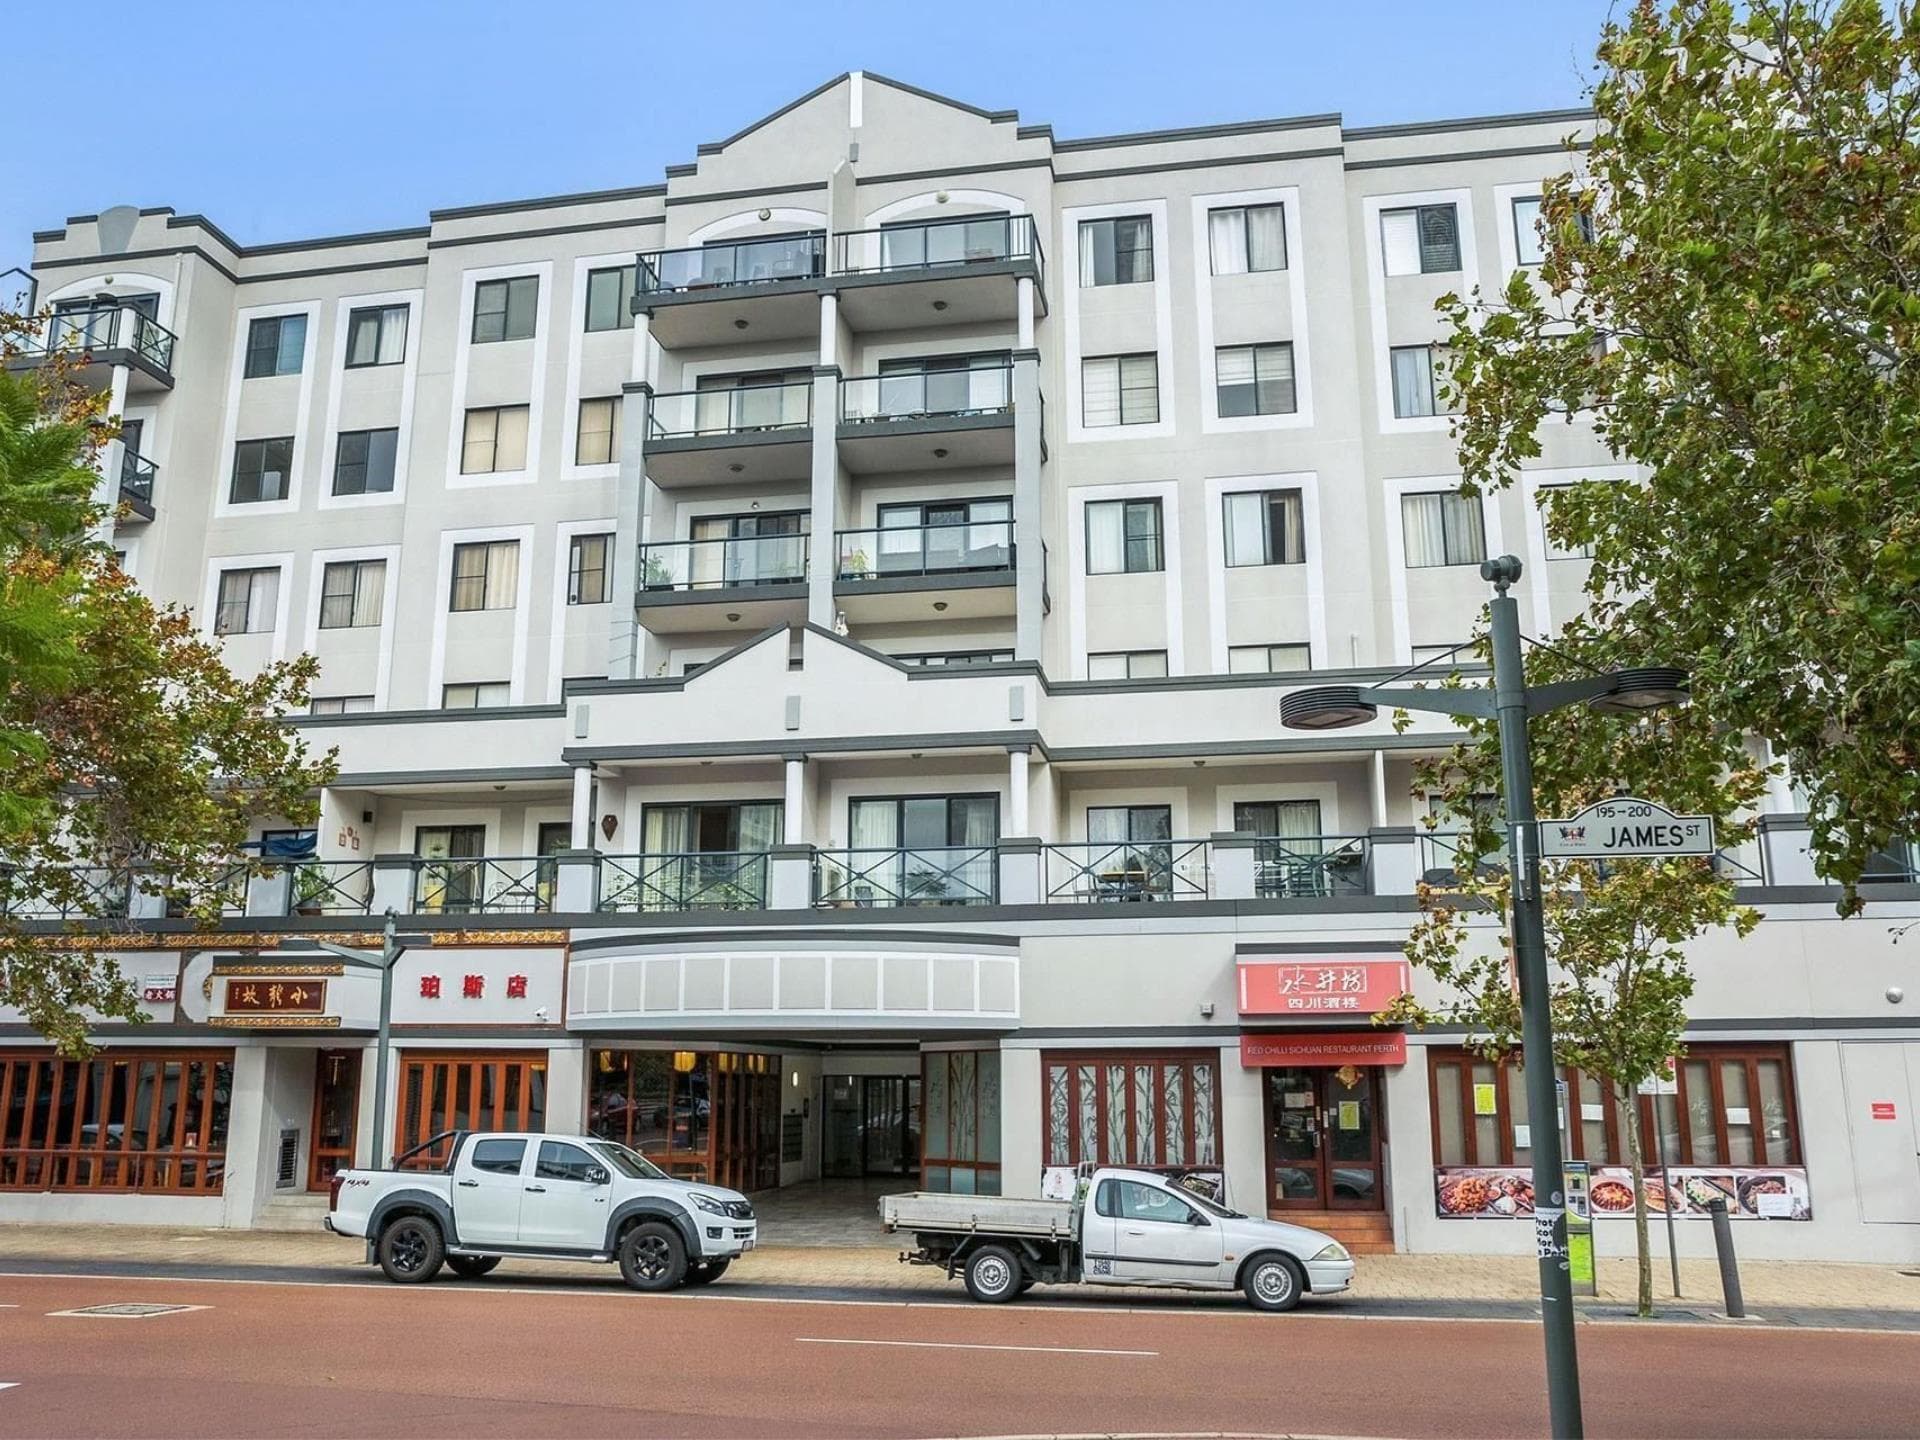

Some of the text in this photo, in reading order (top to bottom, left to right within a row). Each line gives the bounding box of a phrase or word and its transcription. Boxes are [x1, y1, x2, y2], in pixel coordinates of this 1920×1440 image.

[1603, 824, 1701, 848] JAMES ST
[1247, 1046, 1264, 1055] RED
[1264, 1046, 1288, 1055] CHILLI
[1323, 1044, 1372, 1054] RESTAURANT
[1374, 1044, 1399, 1053] PERTH
